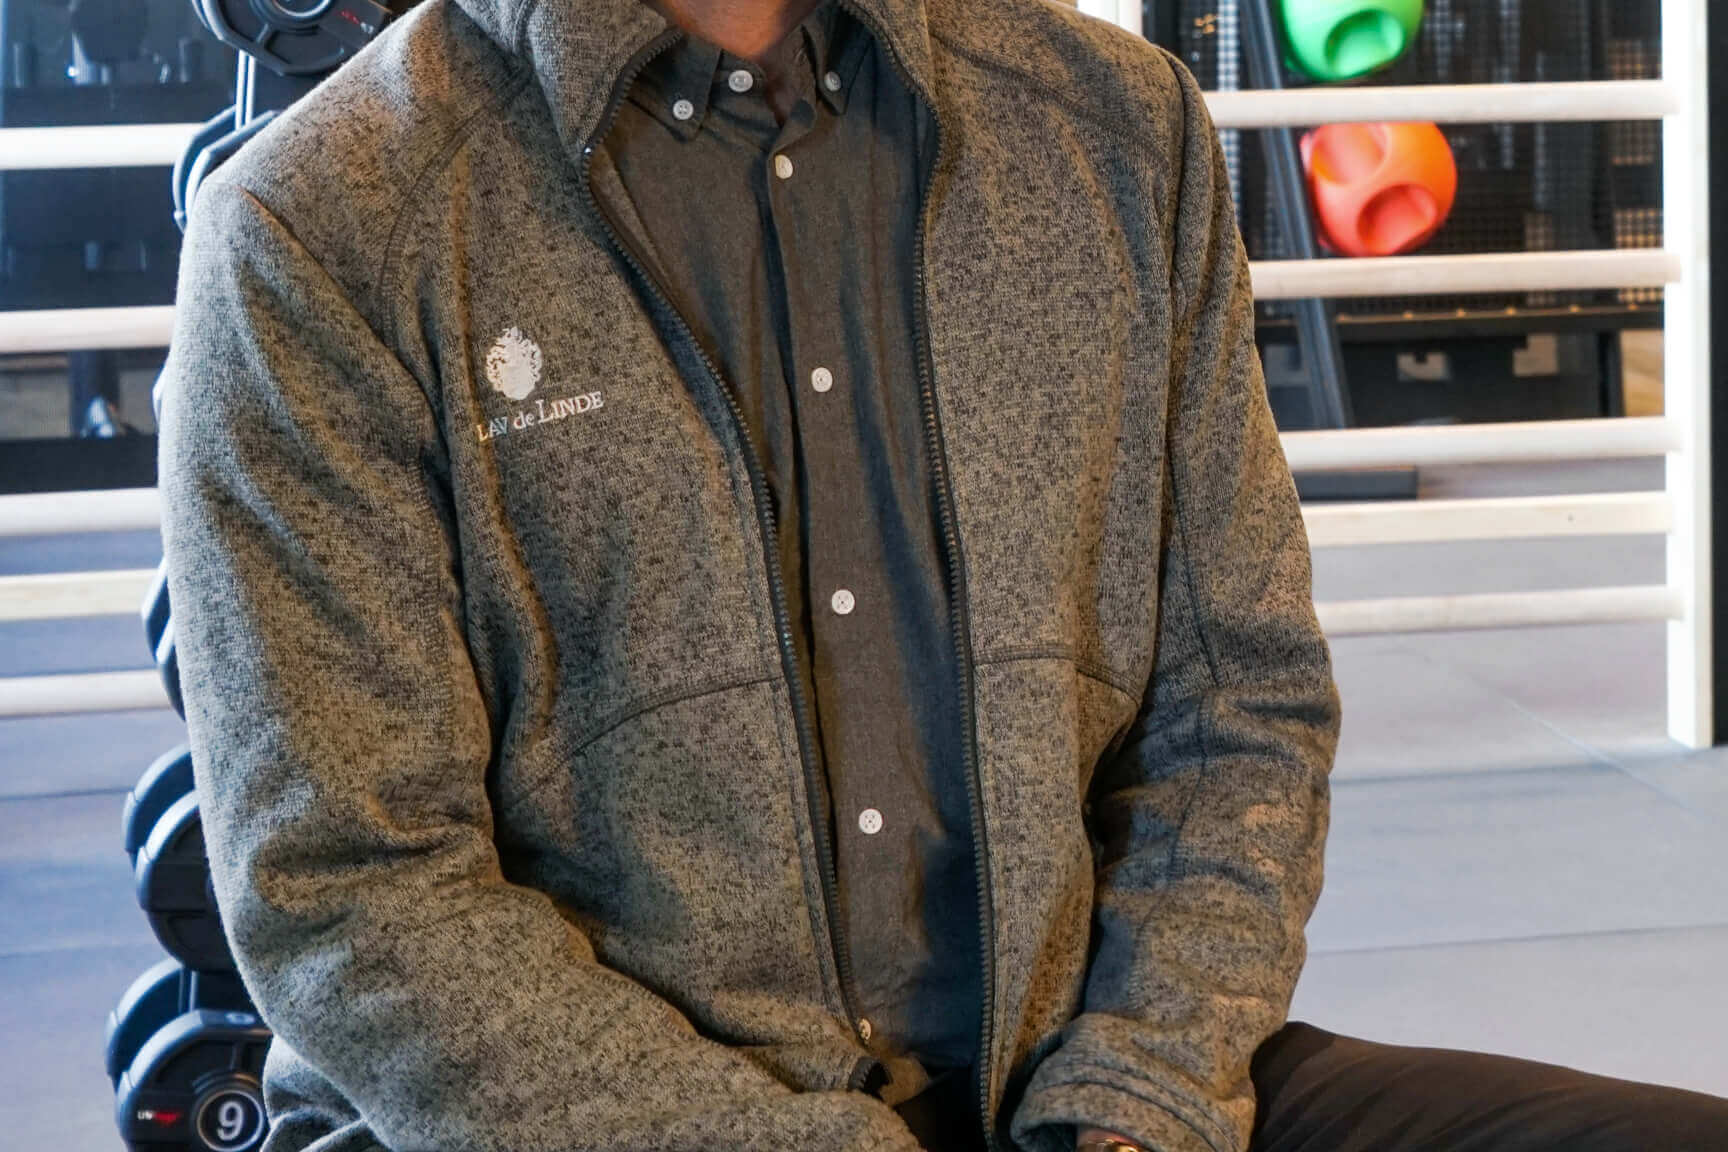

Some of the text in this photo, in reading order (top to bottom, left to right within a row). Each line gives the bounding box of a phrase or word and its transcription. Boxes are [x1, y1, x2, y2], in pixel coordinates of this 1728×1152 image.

[513, 410, 535, 430] de
[535, 391, 605, 424] LINDE
[217, 1101, 244, 1140] 9
